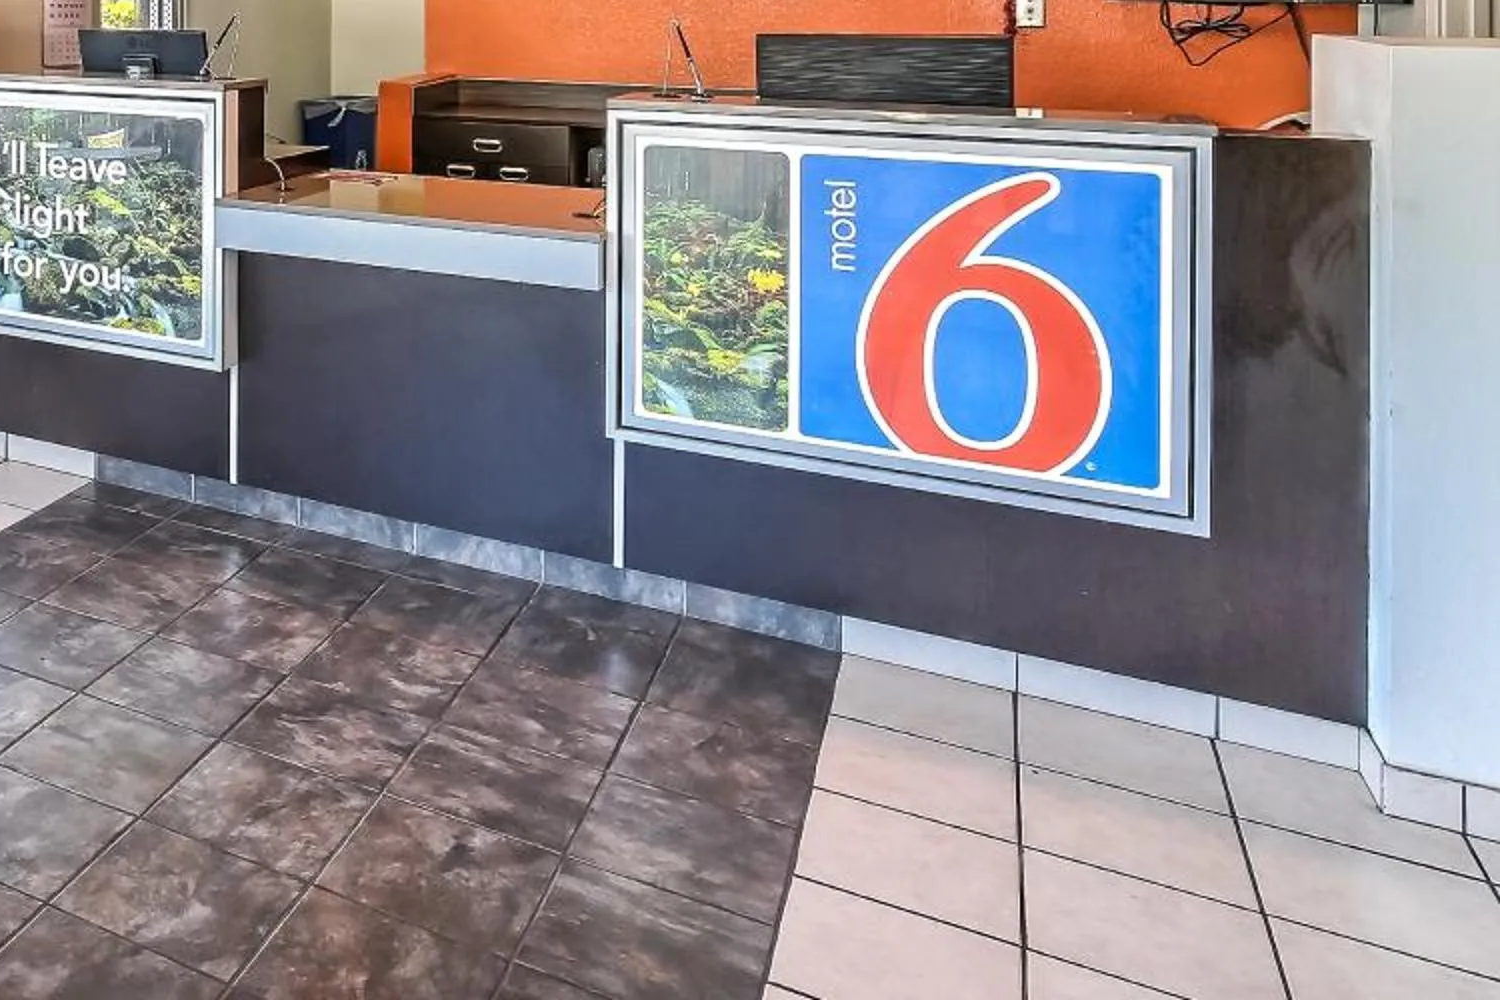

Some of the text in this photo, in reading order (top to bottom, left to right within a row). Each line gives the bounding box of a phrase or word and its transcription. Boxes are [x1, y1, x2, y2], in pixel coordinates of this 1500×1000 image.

[39, 140, 127, 184] leave
[15, 191, 90, 239] light
[1, 242, 48, 279] for
[59, 260, 130, 294] you.
[823, 171, 1113, 477] motel 6
